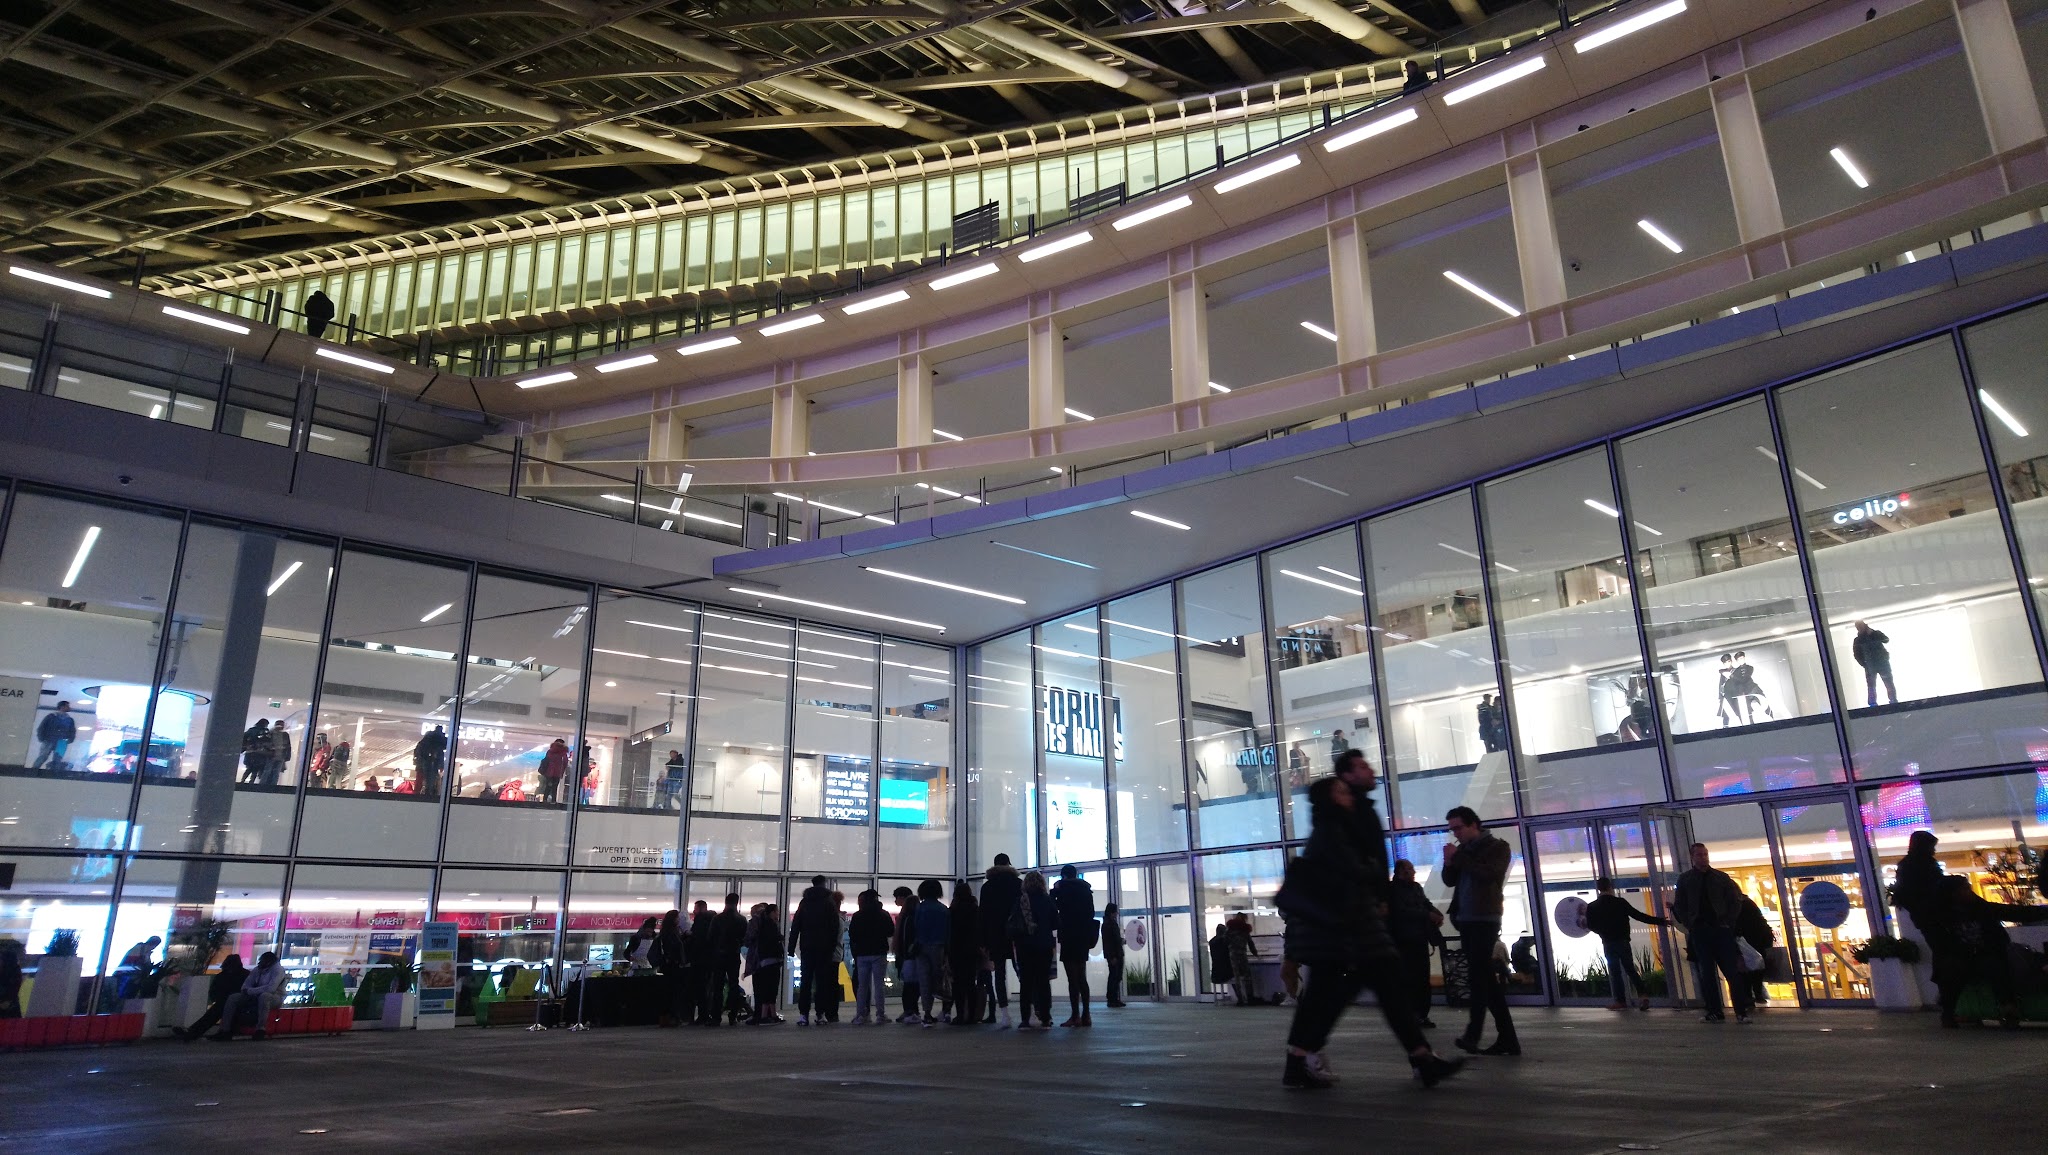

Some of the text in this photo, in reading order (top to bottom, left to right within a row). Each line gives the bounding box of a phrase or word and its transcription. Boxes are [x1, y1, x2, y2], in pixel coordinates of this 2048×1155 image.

[592, 846, 623, 854] OUVERT
[610, 856, 630, 864] OPEN
[298, 916, 353, 926] NOUVEAU
[455, 916, 488, 926] NOUVE
[590, 917, 633, 926] NOUVEAU
